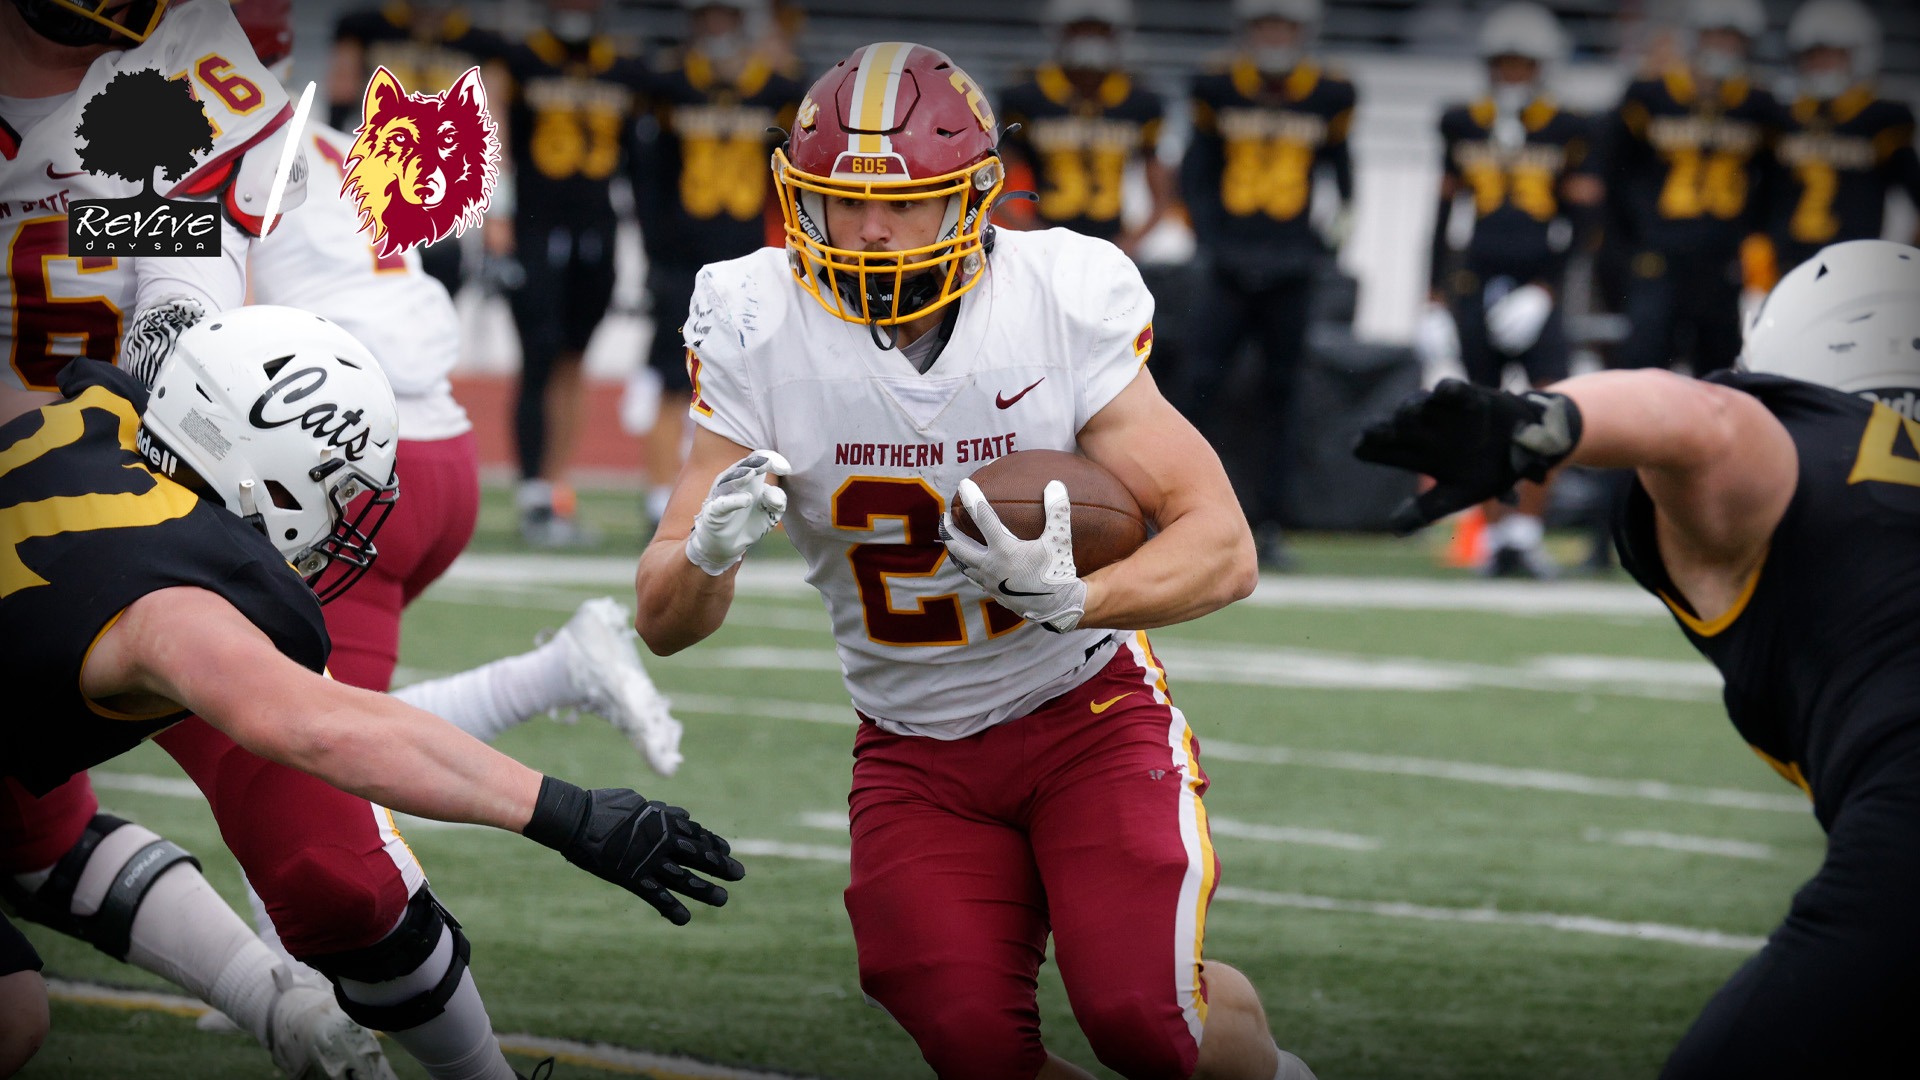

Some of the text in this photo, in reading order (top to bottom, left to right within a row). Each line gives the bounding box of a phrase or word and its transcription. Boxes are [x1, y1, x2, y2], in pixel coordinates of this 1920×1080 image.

[852, 158, 887, 174] 605
[248, 366, 371, 462] Cats
[835, 431, 1019, 467] NORTHERN STATE
